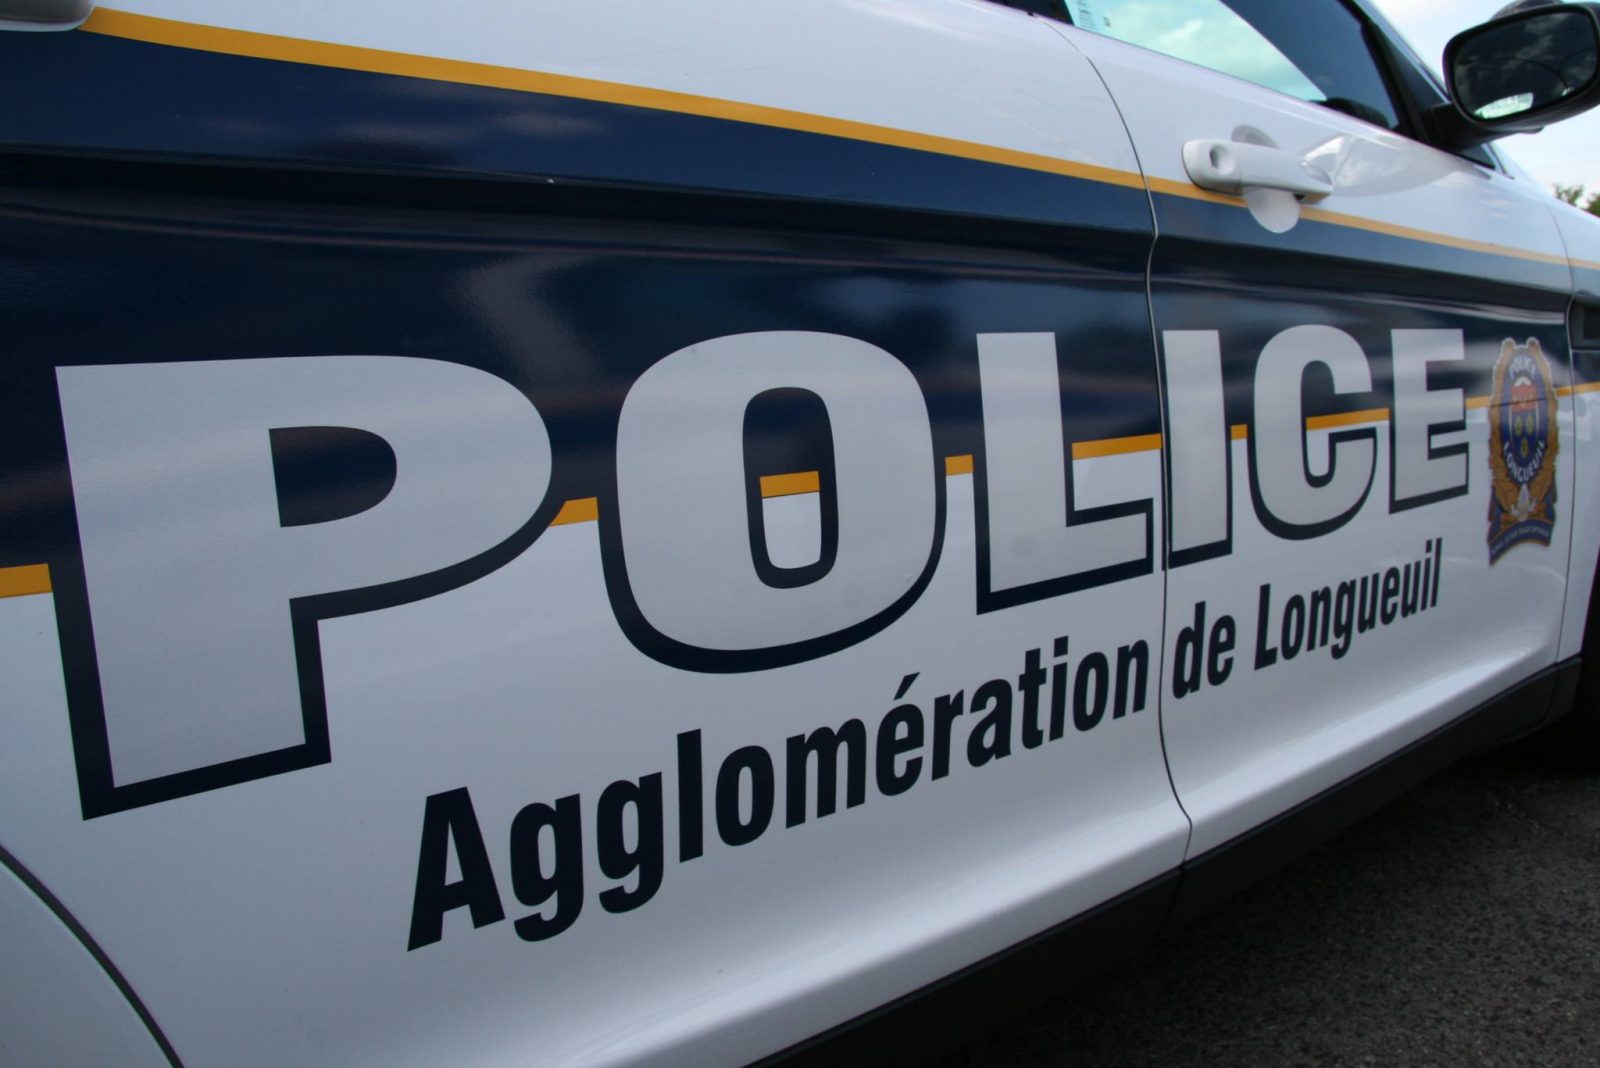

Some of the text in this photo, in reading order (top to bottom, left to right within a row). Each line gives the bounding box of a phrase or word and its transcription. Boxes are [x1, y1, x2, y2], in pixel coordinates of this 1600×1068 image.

[54, 324, 1469, 820] POLICE
[1503, 441, 1544, 483] LONGUEUIL
[407, 537, 1442, 952] Agglomération de Longueuil
